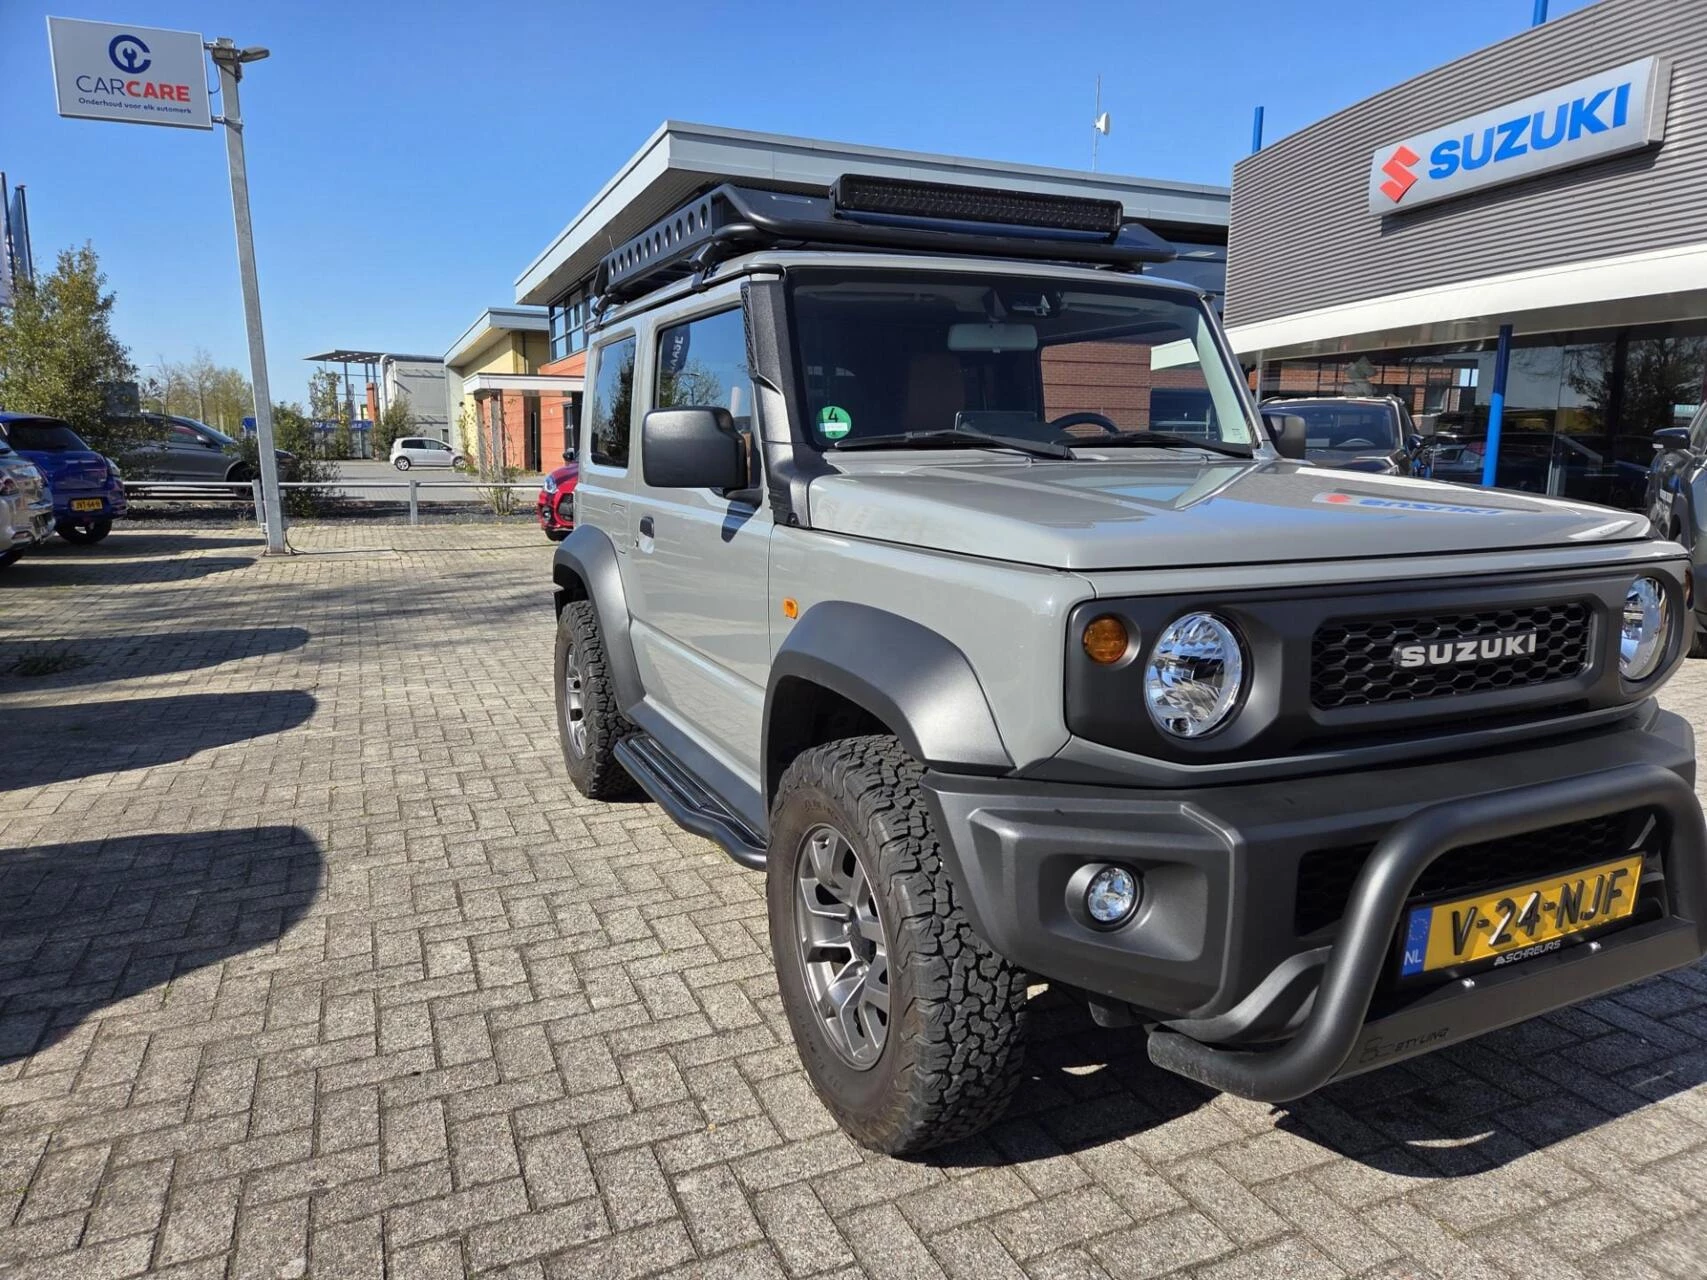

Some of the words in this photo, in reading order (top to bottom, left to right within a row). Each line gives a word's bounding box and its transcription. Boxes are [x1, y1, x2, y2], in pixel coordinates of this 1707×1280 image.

[76, 75, 190, 102] CARCARE
[78, 97, 122, 107] Onderhoud
[1428, 82, 1631, 179] SUZUKI
[828, 408, 838, 423] 4
[1400, 633, 1537, 667] SUZUKI
[1452, 868, 1628, 956] V-24-NJF
[1403, 949, 1422, 967] NL
[1504, 939, 1561, 964] SCHREURS
